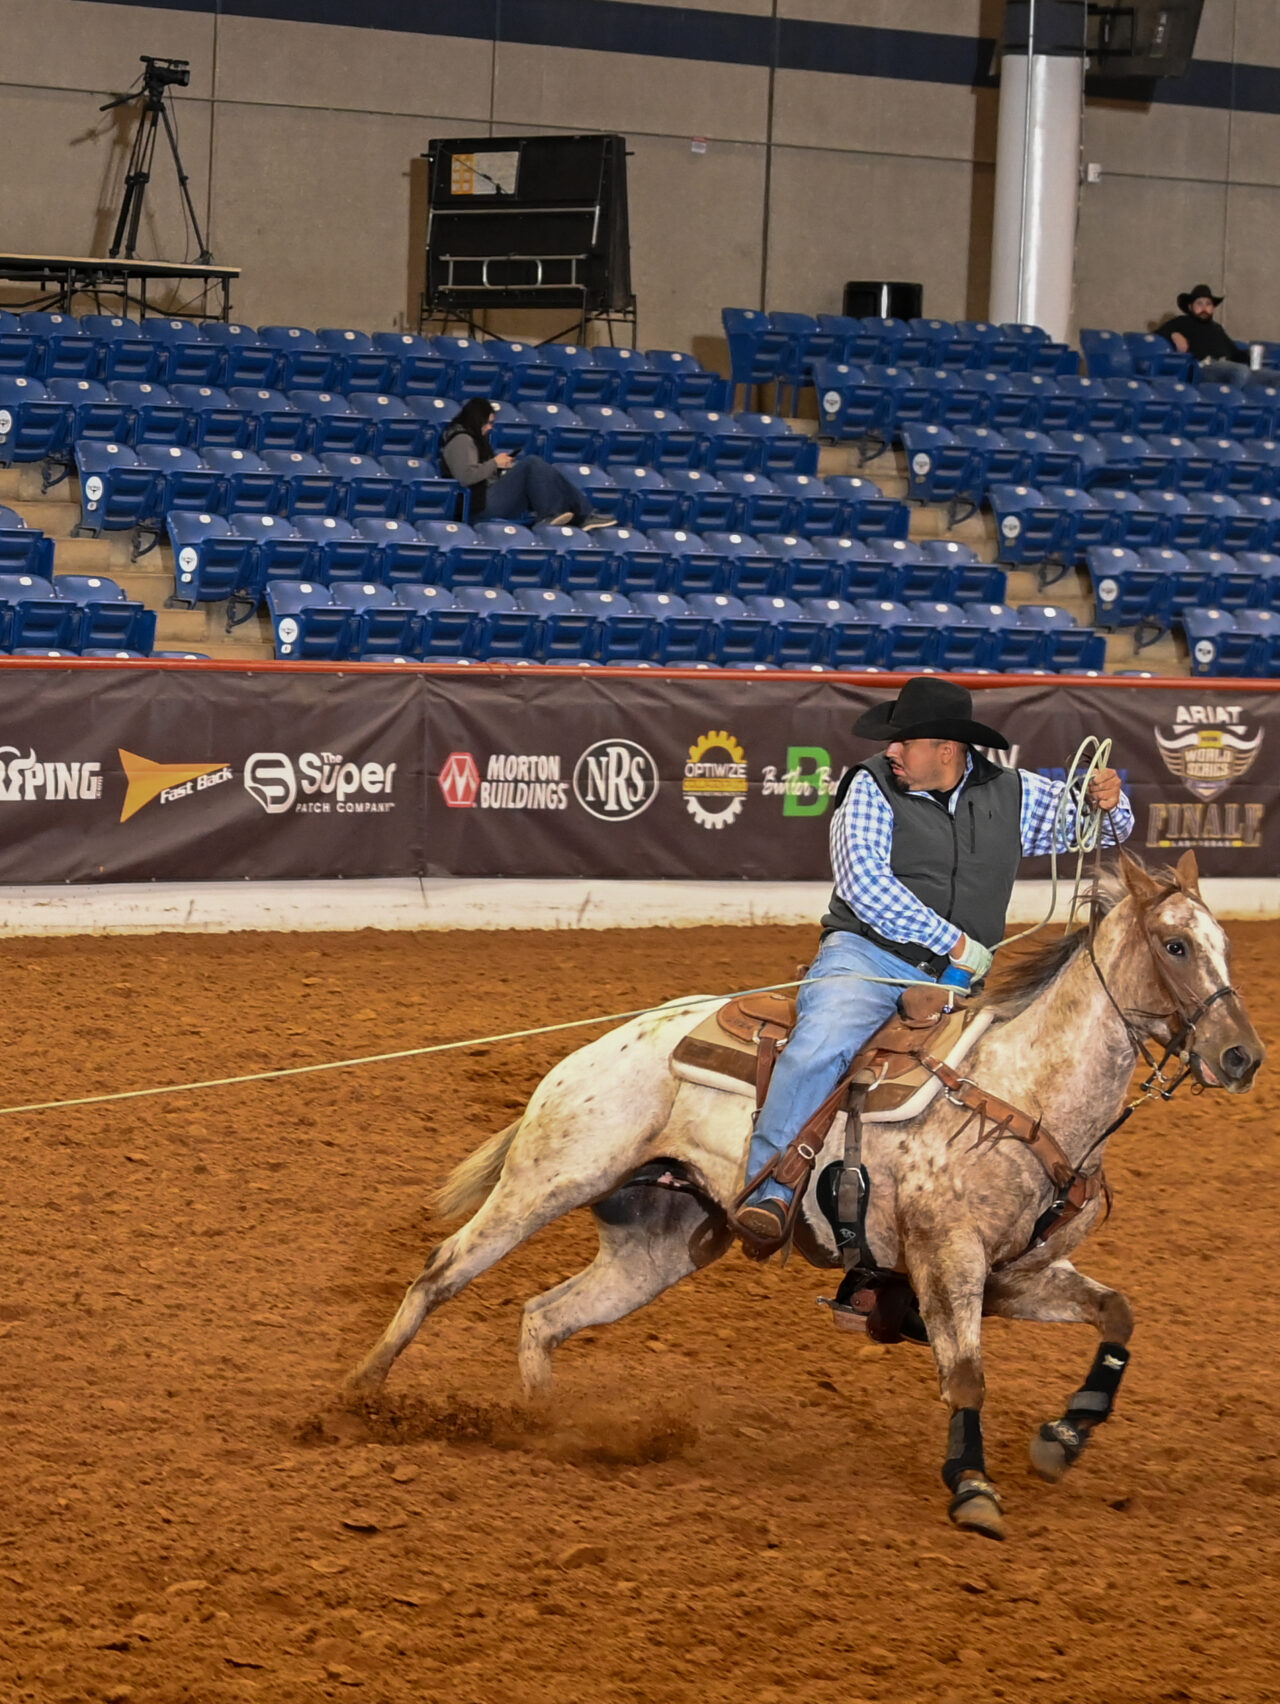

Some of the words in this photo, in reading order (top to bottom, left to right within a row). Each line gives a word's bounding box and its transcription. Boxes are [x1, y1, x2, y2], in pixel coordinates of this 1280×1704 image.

[1176, 705, 1243, 723] ARIAT
[321, 752, 343, 763] The
[487, 754, 560, 780] MORTON
[684, 763, 747, 778] OPTIWIZE
[160, 781, 195, 804] Fast
[196, 767, 234, 791] Back
[298, 752, 397, 801] Super
[585, 746, 646, 811] NRS
[295, 802, 331, 813] PATCH
[480, 782, 570, 810] BUILDINGS
[1146, 803, 1264, 848] FINALE
